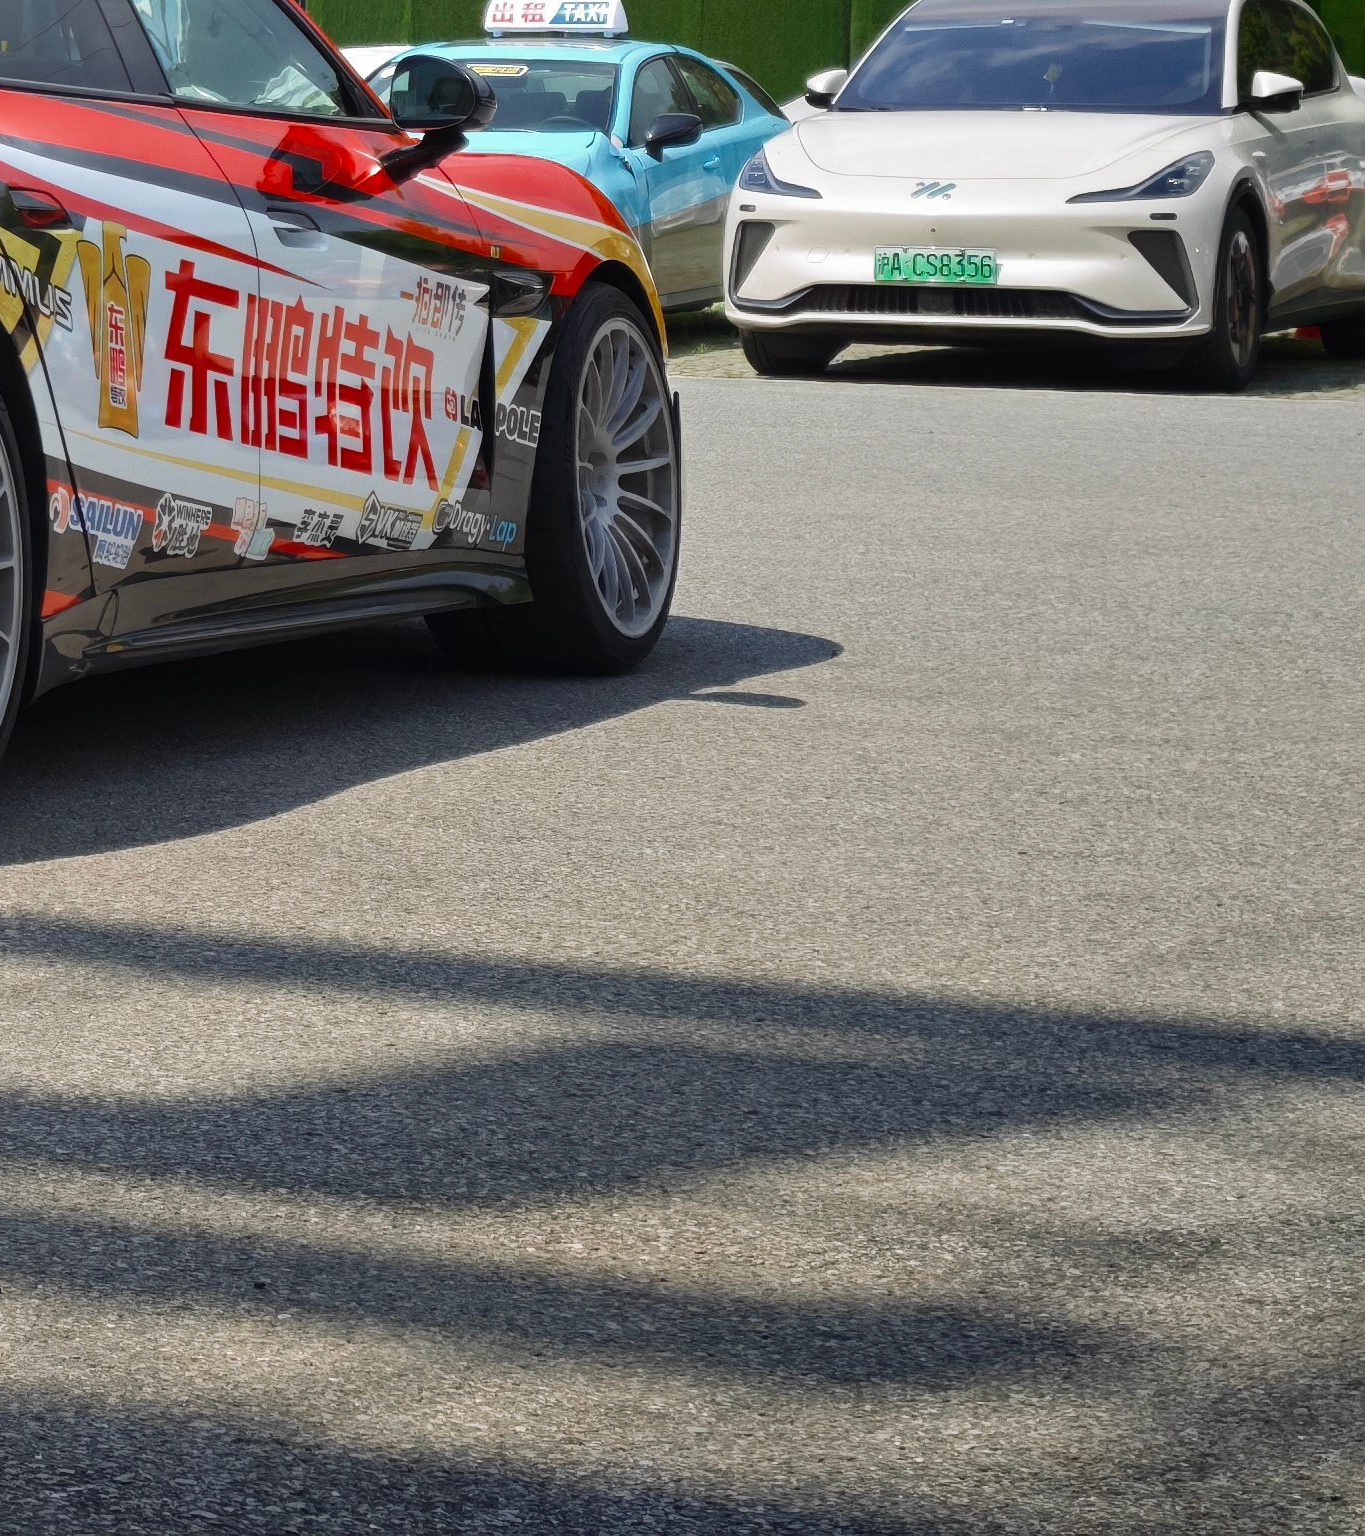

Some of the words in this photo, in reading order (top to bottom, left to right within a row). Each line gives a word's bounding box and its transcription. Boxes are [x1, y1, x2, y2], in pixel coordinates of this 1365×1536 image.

[491, 1, 546, 24] 出租
[563, 3, 610, 23] TAXI
[912, 253, 992, 279] CS8356
[164, 258, 440, 493] 东鹏特饮
[69, 492, 142, 541] SAILUN
